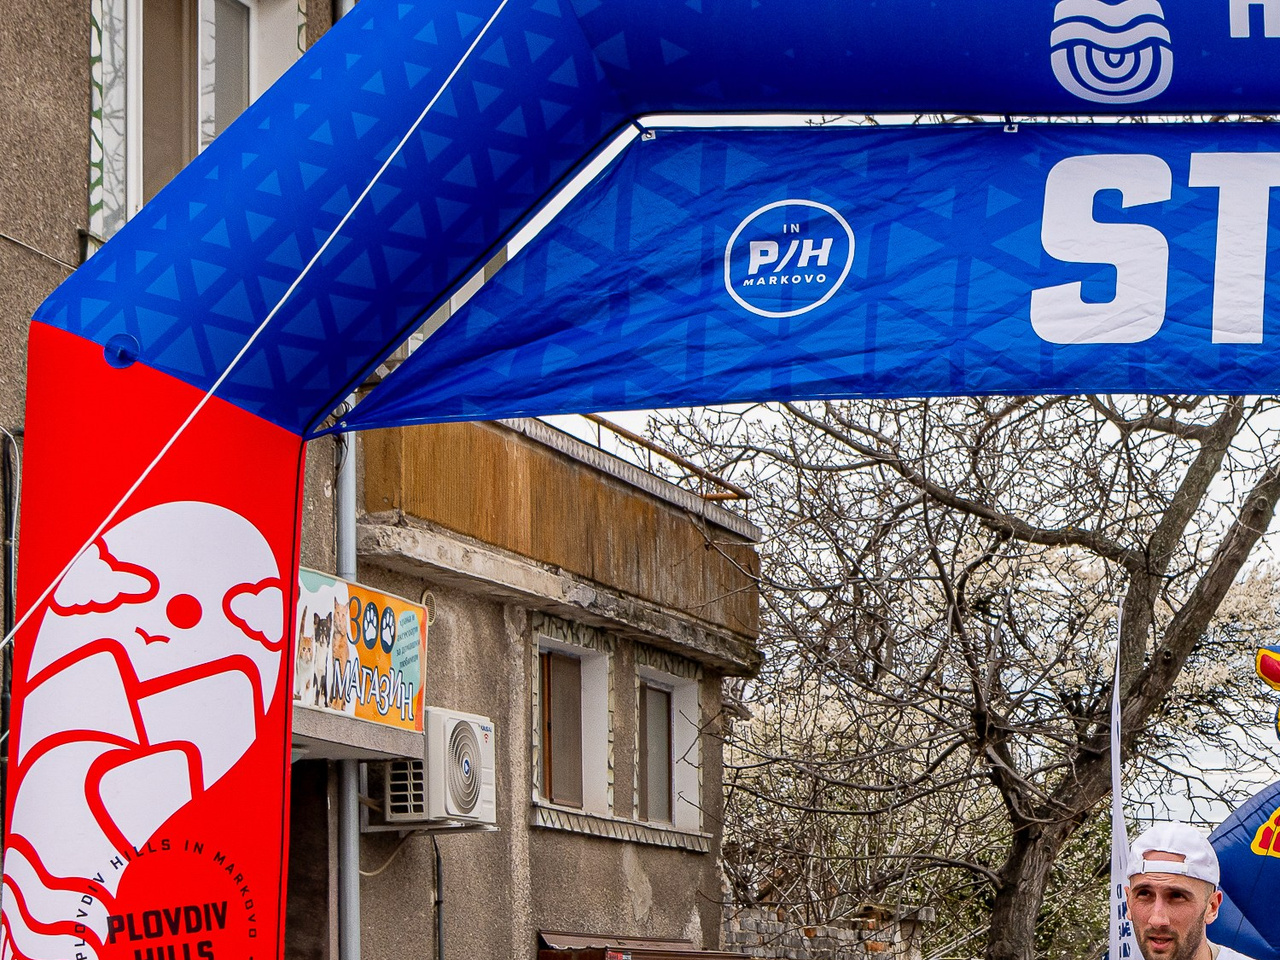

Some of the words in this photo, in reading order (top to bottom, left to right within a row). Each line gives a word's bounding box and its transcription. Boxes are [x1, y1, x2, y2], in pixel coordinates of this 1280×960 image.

[782, 223, 800, 234] IN
[748, 237, 833, 276] P/H
[742, 274, 827, 287] MARKOVO
[333, 657, 414, 721] МАГАЗИН
[110, 839, 170, 870] HILLS
[184, 839, 204, 854] IN
[213, 851, 257, 938] MARKOVO
[106, 901, 228, 945] PLOVDIV
